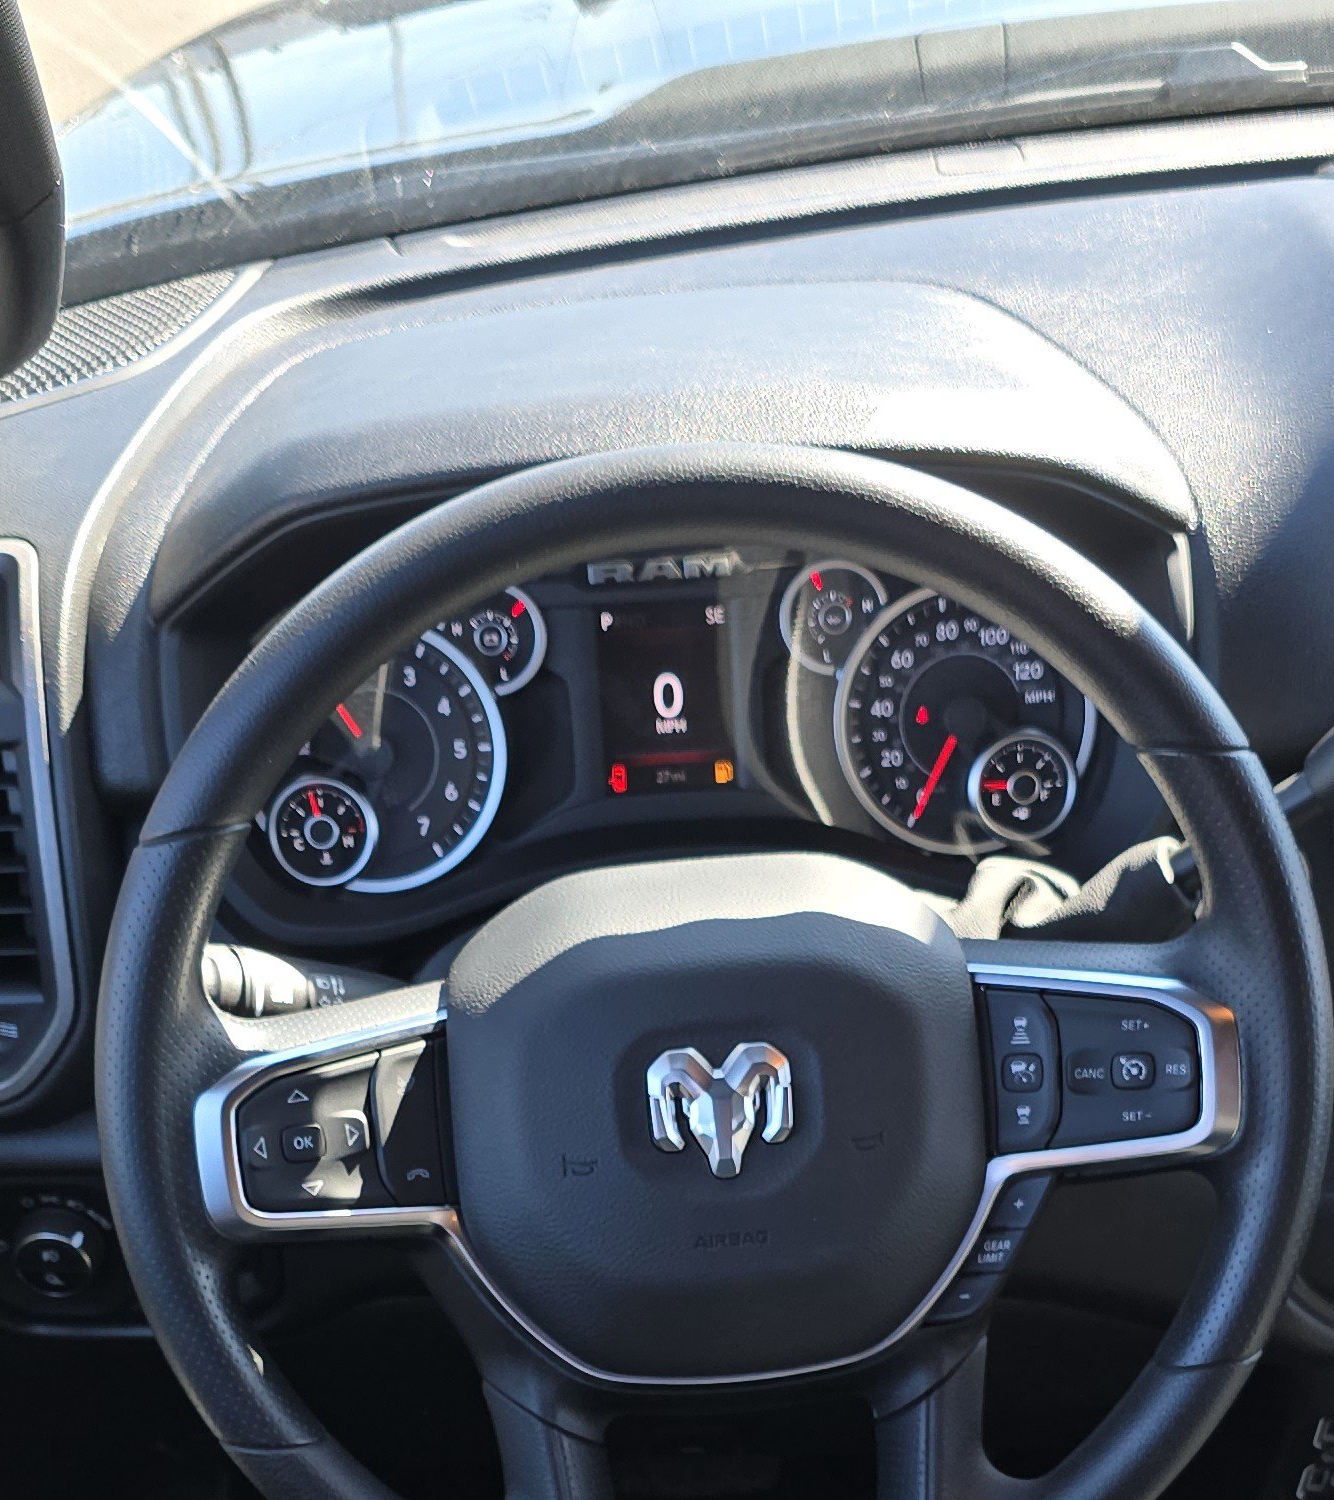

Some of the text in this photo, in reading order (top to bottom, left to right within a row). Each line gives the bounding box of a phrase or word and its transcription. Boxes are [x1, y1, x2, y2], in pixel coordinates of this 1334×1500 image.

[587, 553, 733, 585] RAM
[600, 610, 614, 632] P
[705, 604, 726, 626] SE
[915, 633, 930, 648] 70
[936, 619, 960, 642] 80
[978, 626, 1009, 647] 100
[891, 649, 914, 670] 60
[403, 665, 416, 687] 3
[1012, 659, 1044, 681] 120
[653, 671, 684, 719] 0
[1025, 689, 1056, 705] MPH
[437, 696, 451, 716] 4
[870, 699, 894, 719] 40
[655, 717, 688, 735] MPH
[872, 729, 887, 744] 30
[453, 738, 467, 760] 5
[881, 748, 904, 769] 20
[444, 780, 459, 802] 6
[895, 777, 909, 791] 10
[992, 792, 1002, 807] E
[416, 814, 430, 837] 7
[1074, 1066, 1105, 1081] CANC
[1165, 1064, 1187, 1076] RES
[293, 1135, 314, 1150] OK
[694, 1230, 771, 1249] AIRBAG
[983, 1239, 1012, 1252] GEAR
[978, 1252, 1005, 1265] LIMIT
